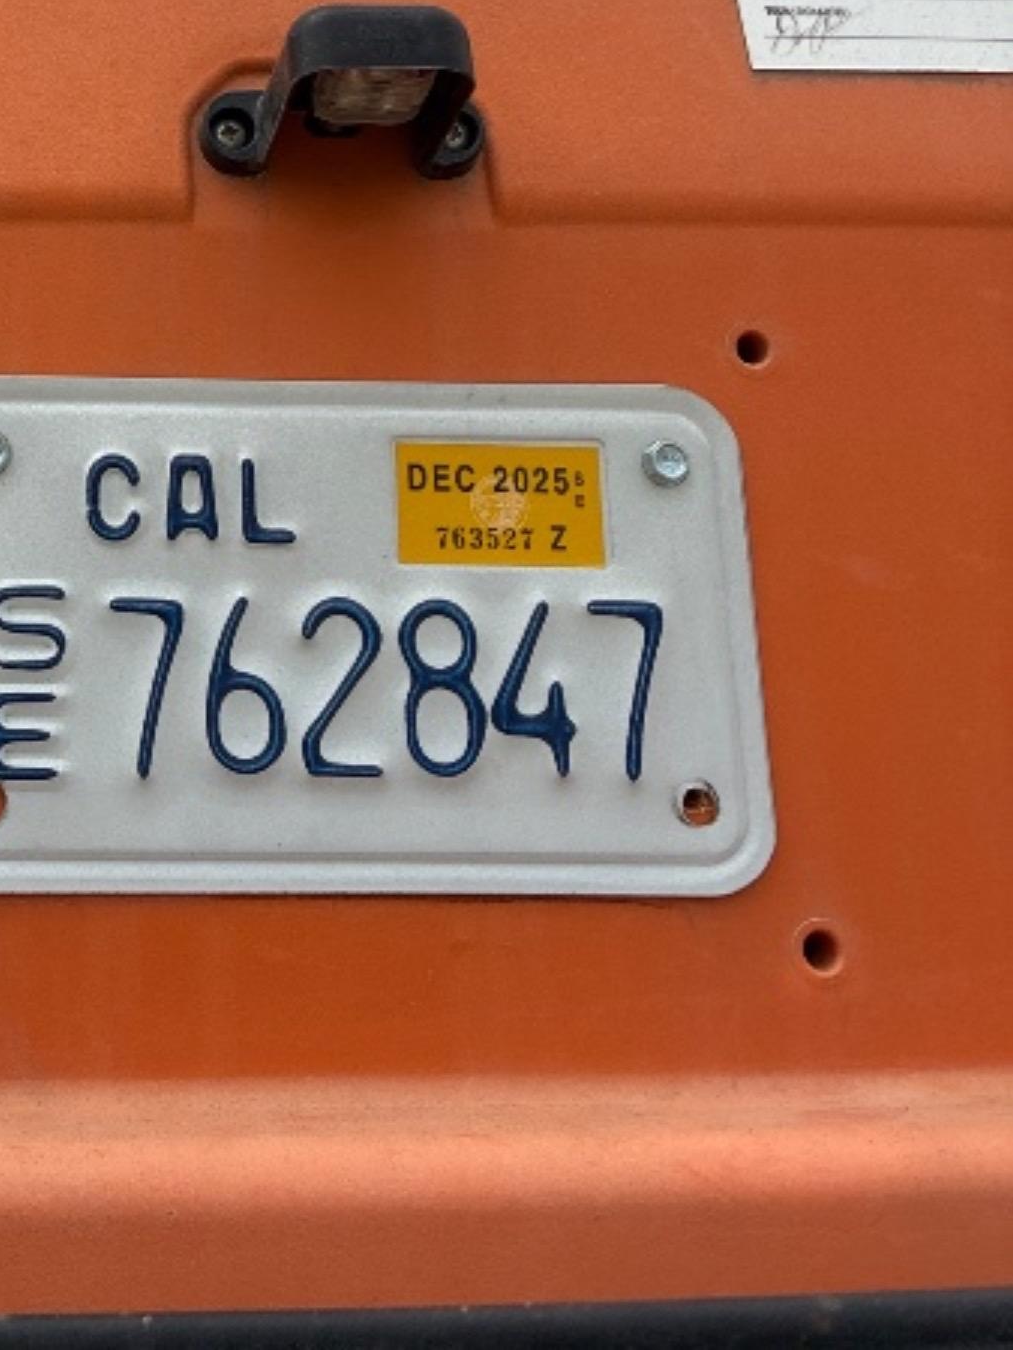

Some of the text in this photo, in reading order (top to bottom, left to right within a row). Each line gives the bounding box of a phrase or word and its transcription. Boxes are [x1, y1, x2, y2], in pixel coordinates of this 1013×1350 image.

[86, 454, 296, 544] CAL
[407, 463, 570, 495] DEC 2025
[436, 525, 567, 551] 763527 Z
[109, 596, 664, 782] 762847
